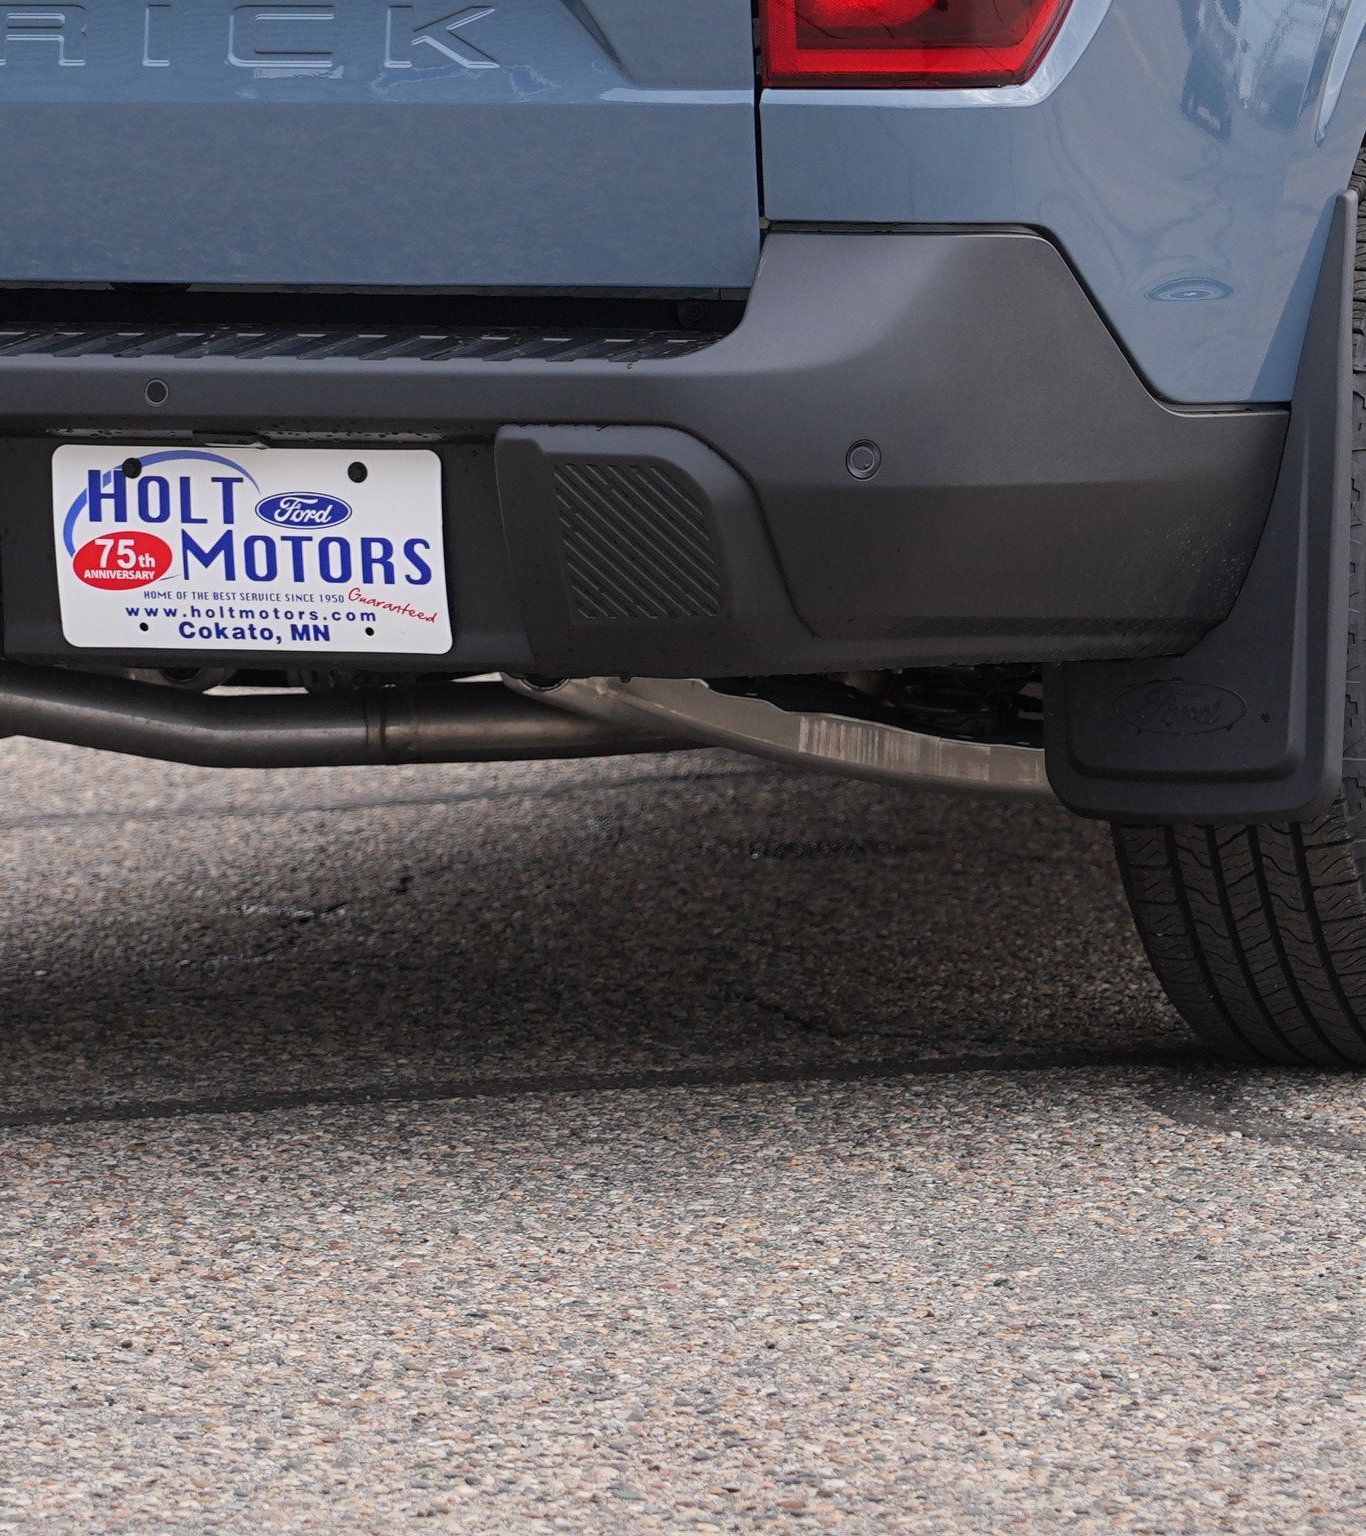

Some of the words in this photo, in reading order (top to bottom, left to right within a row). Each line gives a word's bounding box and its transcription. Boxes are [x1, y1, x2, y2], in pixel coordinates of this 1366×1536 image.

[88, 469, 244, 524] HOLT
[273, 495, 334, 524] Ford
[94, 538, 156, 569] 75th
[181, 529, 433, 586] MOTORS
[84, 569, 156, 580] ANNIVERSARY
[143, 590, 172, 600] HOME
[176, 591, 188, 600] OF
[191, 591, 209, 601] THE
[213, 592, 236, 601] BEST
[239, 592, 281, 602] SERVICE
[285, 593, 315, 603] SINCE
[319, 594, 345, 603] 1950
[348, 587, 438, 623] Guaranteed
[125, 605, 377, 622] www.holtmotors.com
[178, 621, 282, 644] Cokato,
[290, 624, 331, 642] MN
